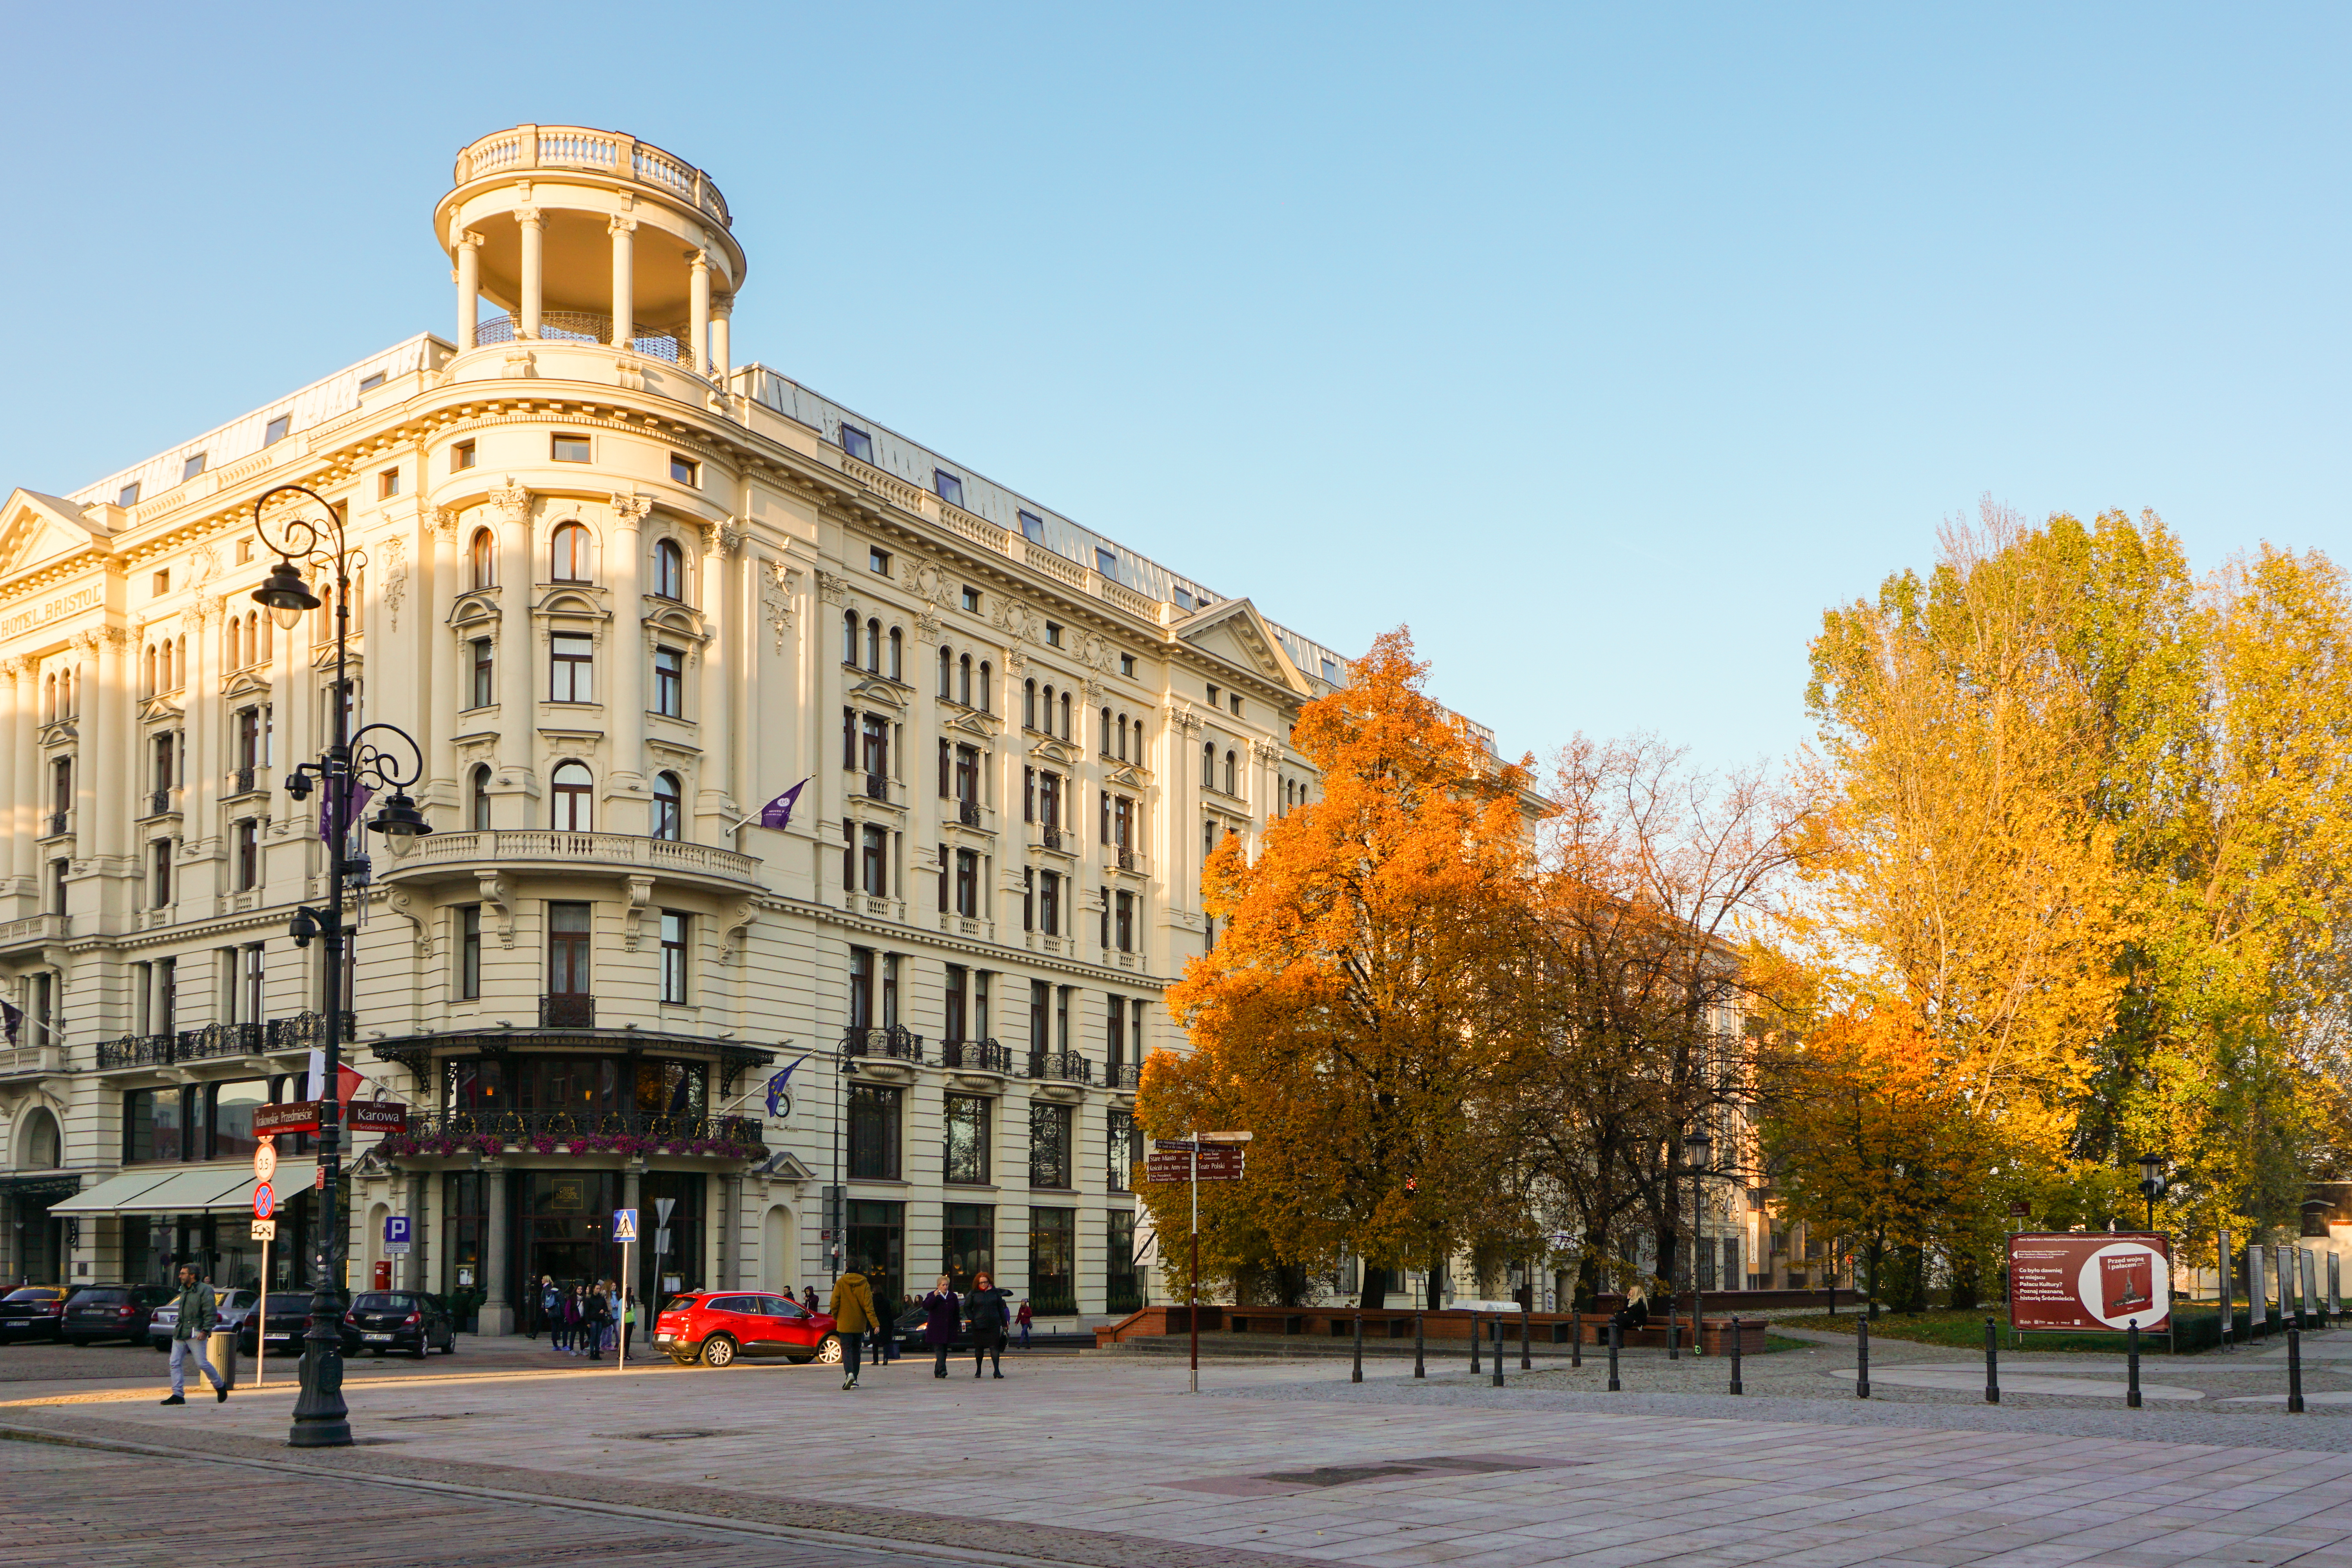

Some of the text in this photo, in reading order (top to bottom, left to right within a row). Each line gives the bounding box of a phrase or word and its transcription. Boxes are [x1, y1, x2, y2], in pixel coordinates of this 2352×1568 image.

[1, 609, 40, 637] HOTEL
[256, 1112, 279, 1127] Krakowskie
[281, 1108, 312, 1123] Przedmieście
[358, 1109, 399, 1122] Karowa
[258, 1158, 269, 1171] 3,5
[391, 1220, 405, 1239] P
